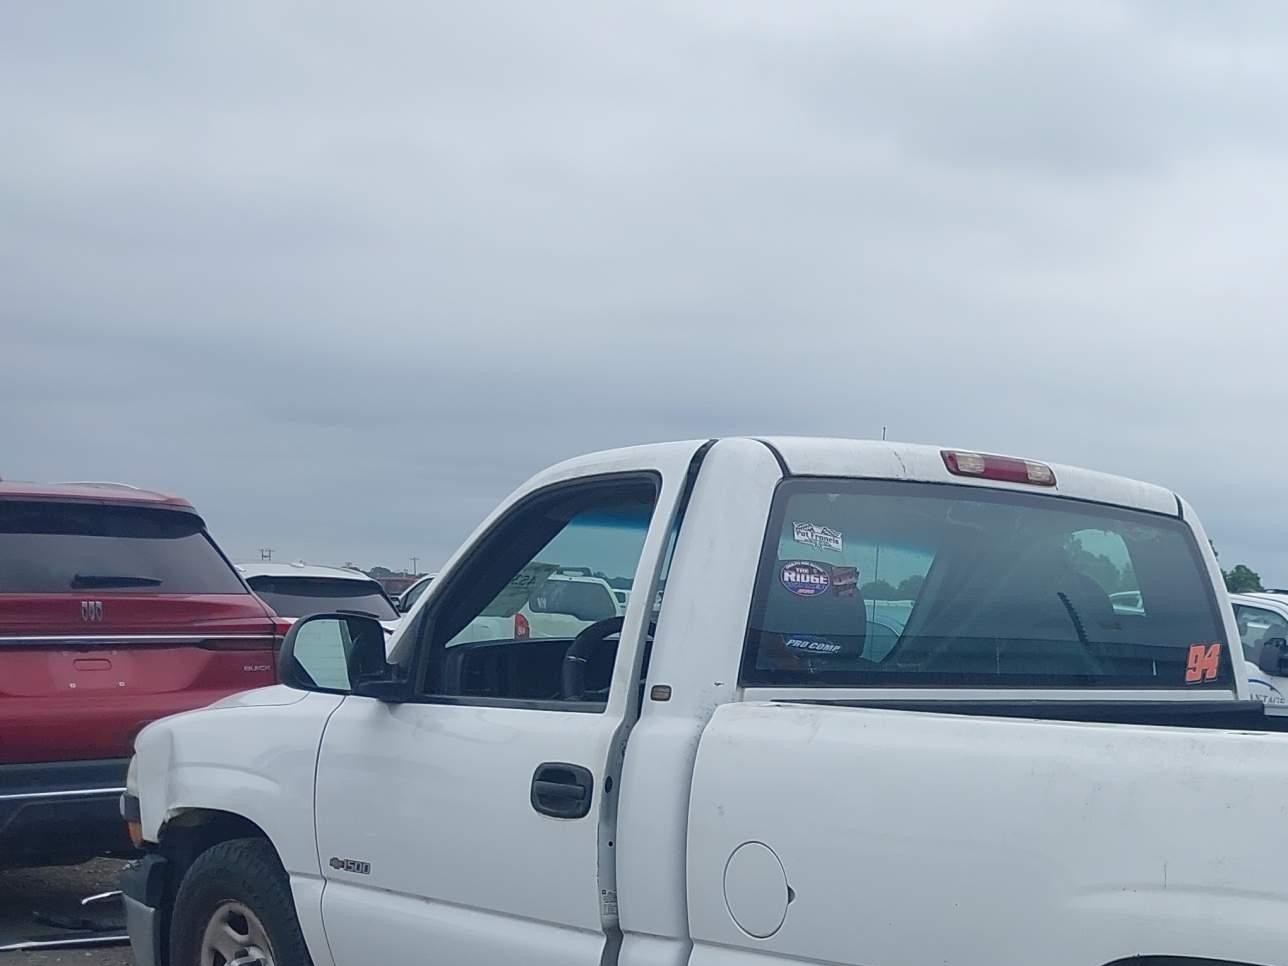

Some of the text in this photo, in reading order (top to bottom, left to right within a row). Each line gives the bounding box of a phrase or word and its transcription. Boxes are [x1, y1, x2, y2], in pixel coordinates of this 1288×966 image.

[783, 570, 828, 585] RIDGE
[786, 639, 841, 652] PRO COMP
[1186, 644, 1221, 682] 94
[343, 859, 371, 874] 1500
